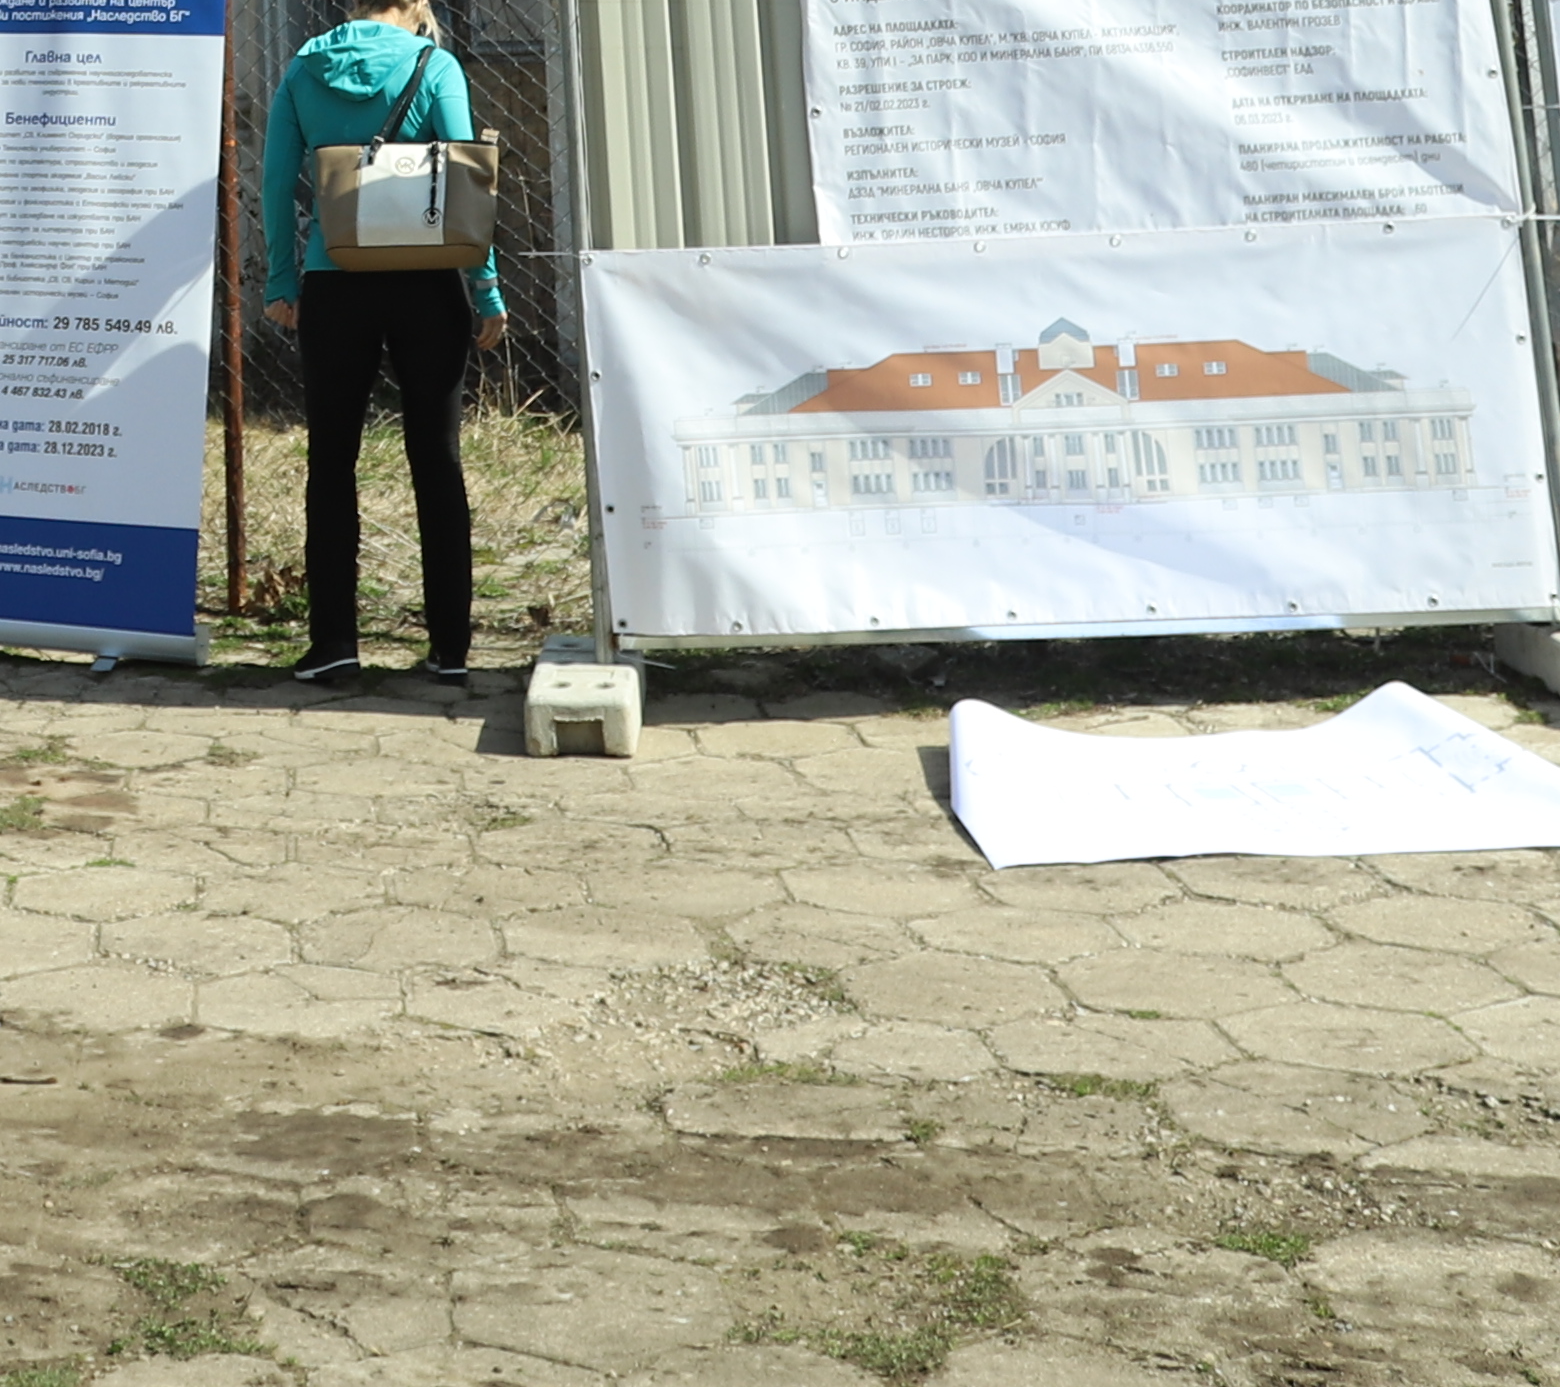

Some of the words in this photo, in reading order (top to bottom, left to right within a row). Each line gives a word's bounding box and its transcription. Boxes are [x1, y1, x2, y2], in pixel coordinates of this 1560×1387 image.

[1217, 0, 1291, 16] КООРДИНАТОР
[1295, 0, 1308, 11] ПО
[11, 10, 84, 21] постижения
[86, 10, 166, 24] „Наследство
[1247, 17, 1299, 30] ВАЛЕНТИН
[1302, 15, 1341, 28] ГРОЗЕВ
[834, 23, 867, 36] АДРЕС
[869, 22, 882, 34] НА
[886, 19, 958, 34] ПЛОЩАДКАТА:
[890, 35, 923, 50] РАЙОН
[1032, 30, 1059, 42] ОВЧА
[1061, 29, 1091, 41] КУПЕЛ
[25, 50, 71, 63] Главна
[77, 53, 102, 65] цел
[871, 56, 891, 68] УПИ
[957, 52, 977, 63] КОО
[981, 51, 987, 62] И
[990, 48, 1051, 61] МИНЕРАЛНА
[1089, 45, 1103, 56] ПИ
[1221, 47, 1287, 61] СТРОИТЕЛЕН
[1291, 45, 1336, 59] НАДЗОР:
[1294, 63, 1314, 76] ЕАД
[839, 81, 909, 95] РАЗРЕШЕНИЕ
[911, 81, 923, 92] ЗА
[926, 78, 971, 91] СТРОЕЖ:
[1232, 97, 1255, 109] ДАТА
[1258, 96, 1271, 107] НА
[1274, 92, 1334, 106] ОТКРИВАНЕ
[1336, 92, 1350, 103] НА
[1354, 87, 1428, 103] ПЛОЩАДКАТА:
[5, 112, 116, 127] Бенефициенти
[843, 125, 915, 139] ВЪЗЛОЖИТЕЛ:
[844, 142, 908, 155] РЕГИОНАЛЕН
[911, 138, 982, 152] ИСТОРИЧЕСКИ
[985, 135, 1020, 148] МУЗЕЙ
[1030, 134, 1066, 146] СОФИЯ
[1239, 141, 1299, 154] ПЛАНИРАНА
[1302, 136, 1403, 152] ПРОДЪЛЖИТЕЛНОСТ
[1407, 135, 1421, 146] НА
[1424, 132, 1467, 145] РАБОТА:
[1421, 152, 1440, 163] дни
[847, 167, 919, 181] ИЗПЪЛНИТЕЛ:
[848, 186, 875, 199] ДЗЗД
[944, 181, 970, 193] БАНЯ
[1244, 192, 1299, 205] ПЛАНИРАН
[1302, 188, 1375, 202] МАКСИМАЛЕН
[1379, 185, 1405, 198] БРОЙ
[1409, 183, 1463, 197] РАБОТЕЩИ
[851, 210, 918, 224] ТЕХНИЧЕСКИ
[921, 206, 999, 221] РЪКОВОДИТЕЛ:
[1245, 212, 1259, 222] НА
[1261, 208, 1339, 222] СТРОИТЕЛНАТА
[1343, 205, 1405, 219] ПЛОЩАДКА:
[882, 228, 915, 239] ОРЛИН
[1004, 222, 1036, 234] ЕМРАХ
[1039, 220, 1070, 232] ЮСУФ
[53, 316, 69, 330] 29
[75, 317, 99, 332] 785
[104, 318, 152, 333] 549.49
[155, 321, 178, 335] лв.
[49, 342, 64, 352] от
[68, 342, 83, 353] ЕС
[87, 343, 119, 354] ЕФРР
[2, 355, 14, 365] 25
[17, 355, 35, 366] 317
[38, 356, 69, 367] 717.06
[71, 357, 87, 368] лв.
[37, 373, 120, 388] съфинансиране
[1, 386, 7, 395] 4
[10, 386, 29, 397] 467
[32, 387, 67, 398] 832.43
[69, 388, 84, 400] лв.
[12, 420, 45, 435] дата:
[48, 420, 110, 437] 28.02.2018
[113, 427, 123, 437] г.
[8, 440, 40, 454] дата:
[44, 441, 104, 457] 28.12.2023
[107, 447, 117, 458] г.
